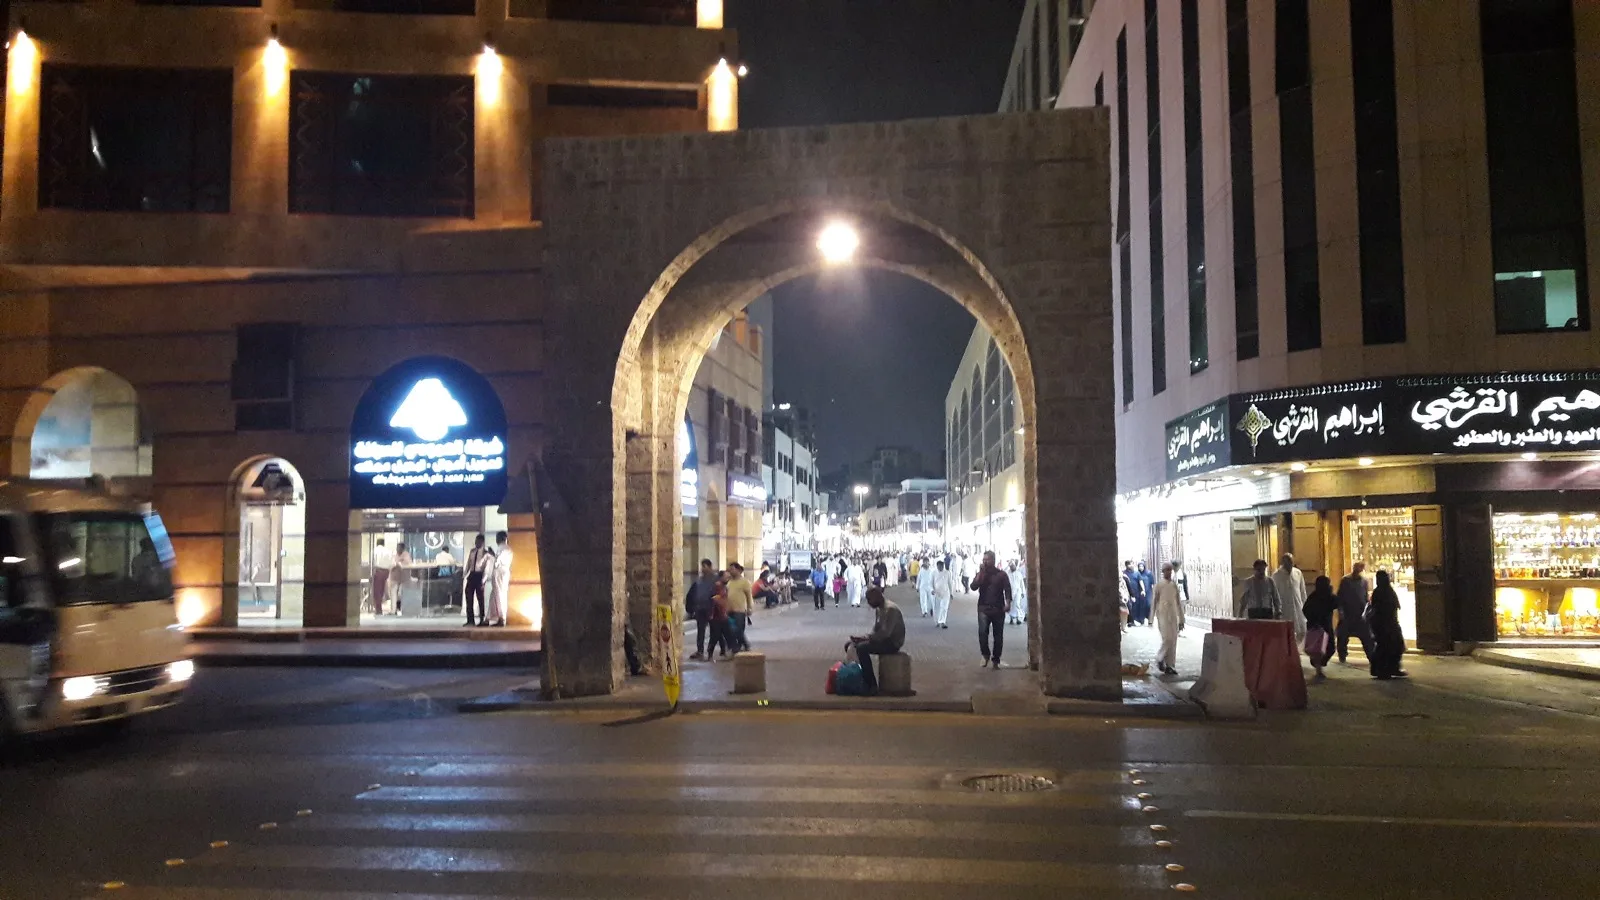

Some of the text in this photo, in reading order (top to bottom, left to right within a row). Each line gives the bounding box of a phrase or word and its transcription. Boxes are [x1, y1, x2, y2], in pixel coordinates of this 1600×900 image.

[1272, 401, 1385, 446] إبراهيم القرشي
[1411, 385, 1600, 430] هيم القرشي
[1191, 413, 1225, 454] إبراهيم
[1453, 429, 1511, 447] والعطور
[1512, 428, 1562, 447] والعنبر
